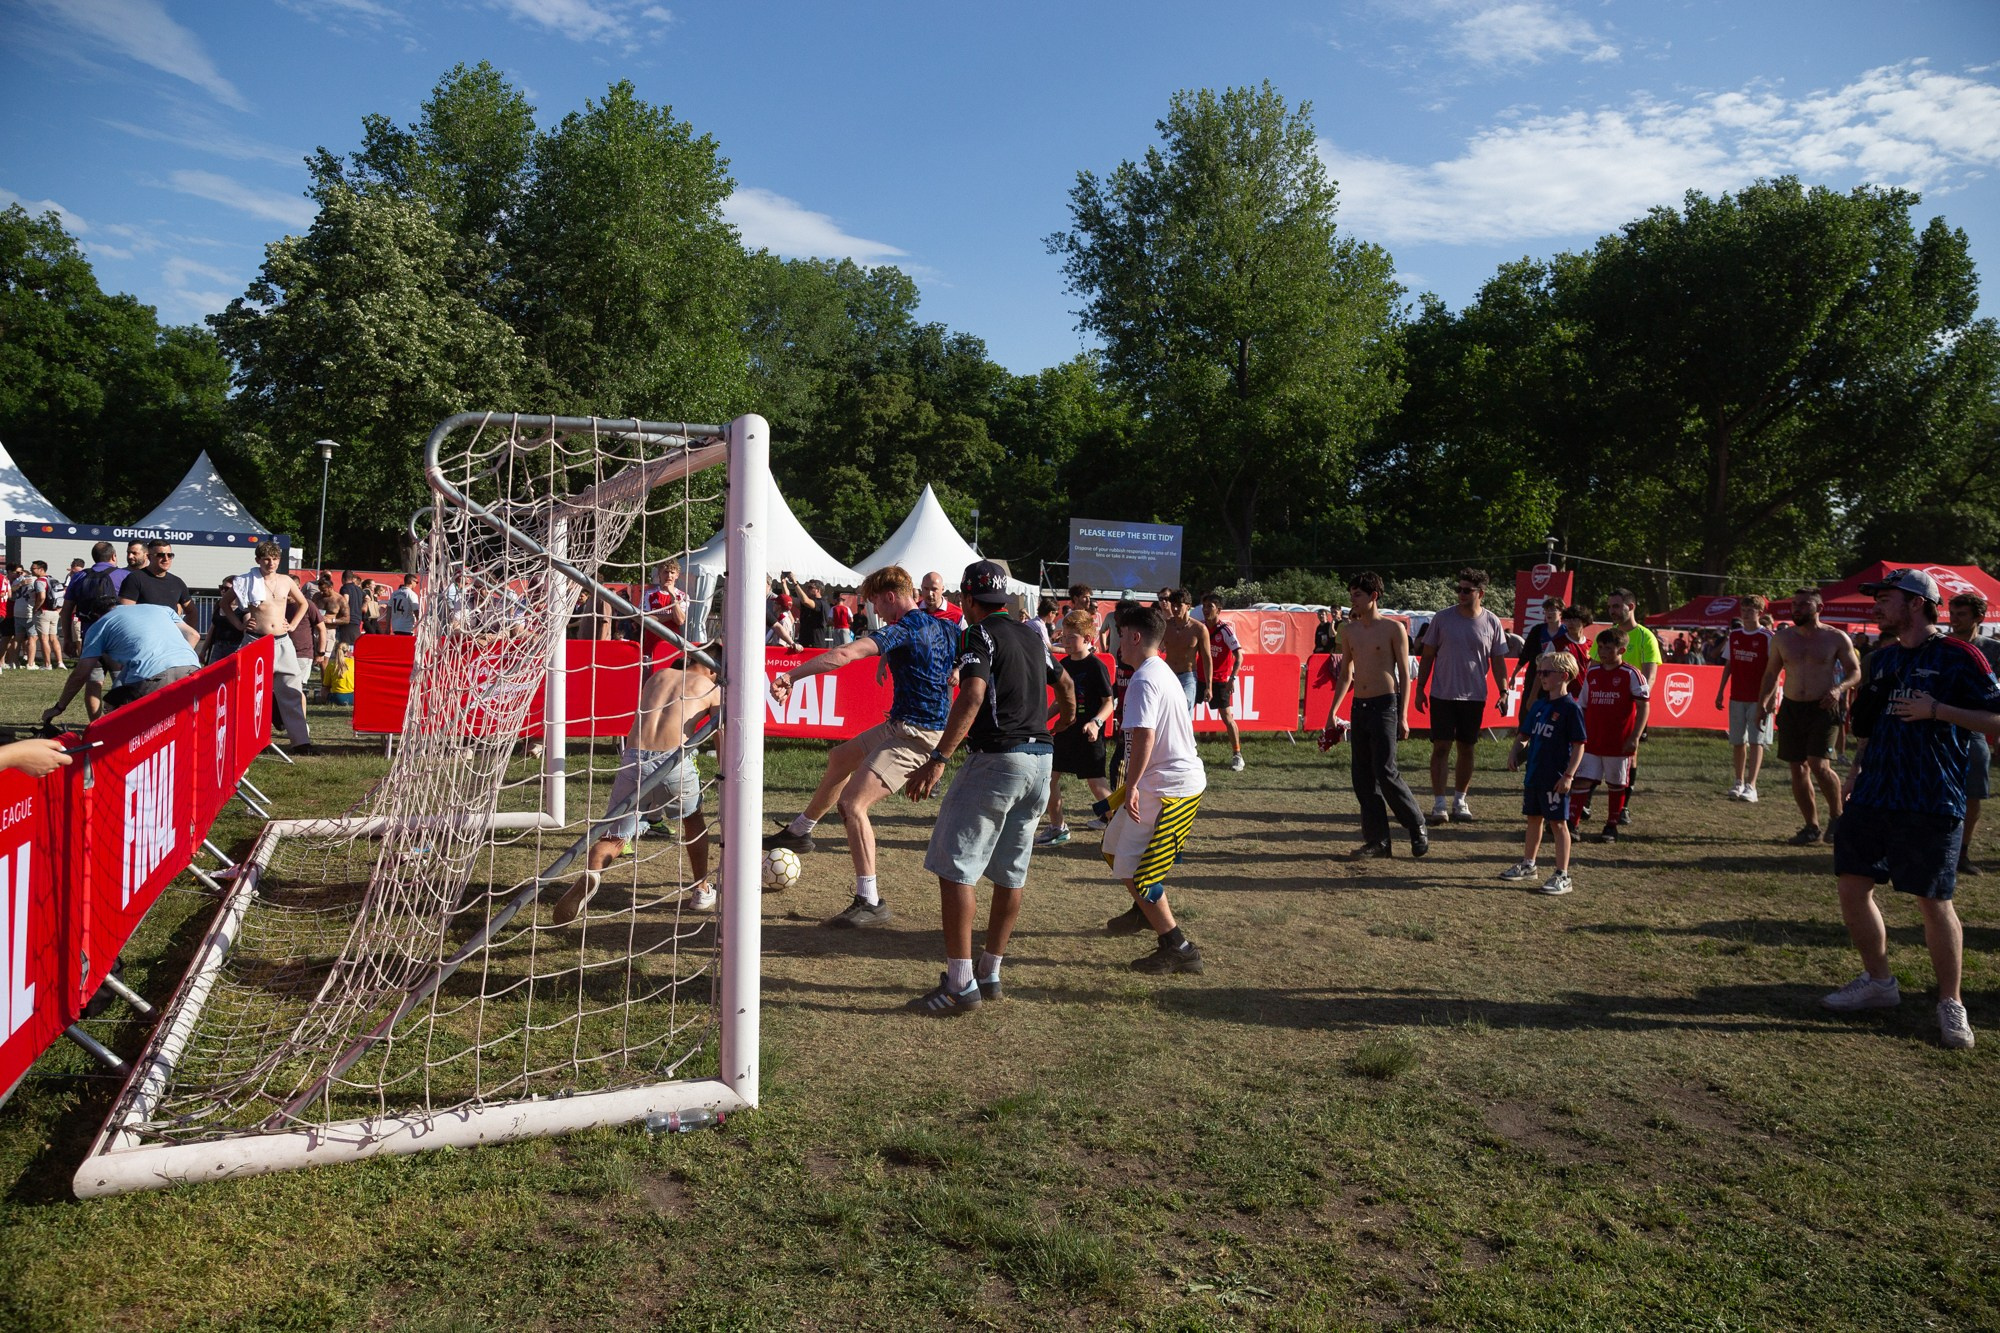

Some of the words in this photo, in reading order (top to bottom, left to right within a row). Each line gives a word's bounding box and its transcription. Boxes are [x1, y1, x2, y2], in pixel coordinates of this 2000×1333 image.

[113, 528, 162, 540] OFFICIAL
[164, 530, 194, 541] SHOP
[1079, 528, 1105, 537] PLEASE
[1107, 530, 1126, 538] KEEP
[1127, 532, 1141, 540] THE
[1158, 534, 1174, 542] TIDY
[392, 598, 405, 615] 14
[1669, 680, 1690, 688] Arsenal
[128, 734, 141, 754] UEFA
[141, 719, 164, 746] CHAMPIONS
[163, 713, 176, 732] LEAGUE
[1546, 791, 1561, 804] 14
[0, 796, 33, 833] EAGUE
[122, 740, 176, 911] FINAL
